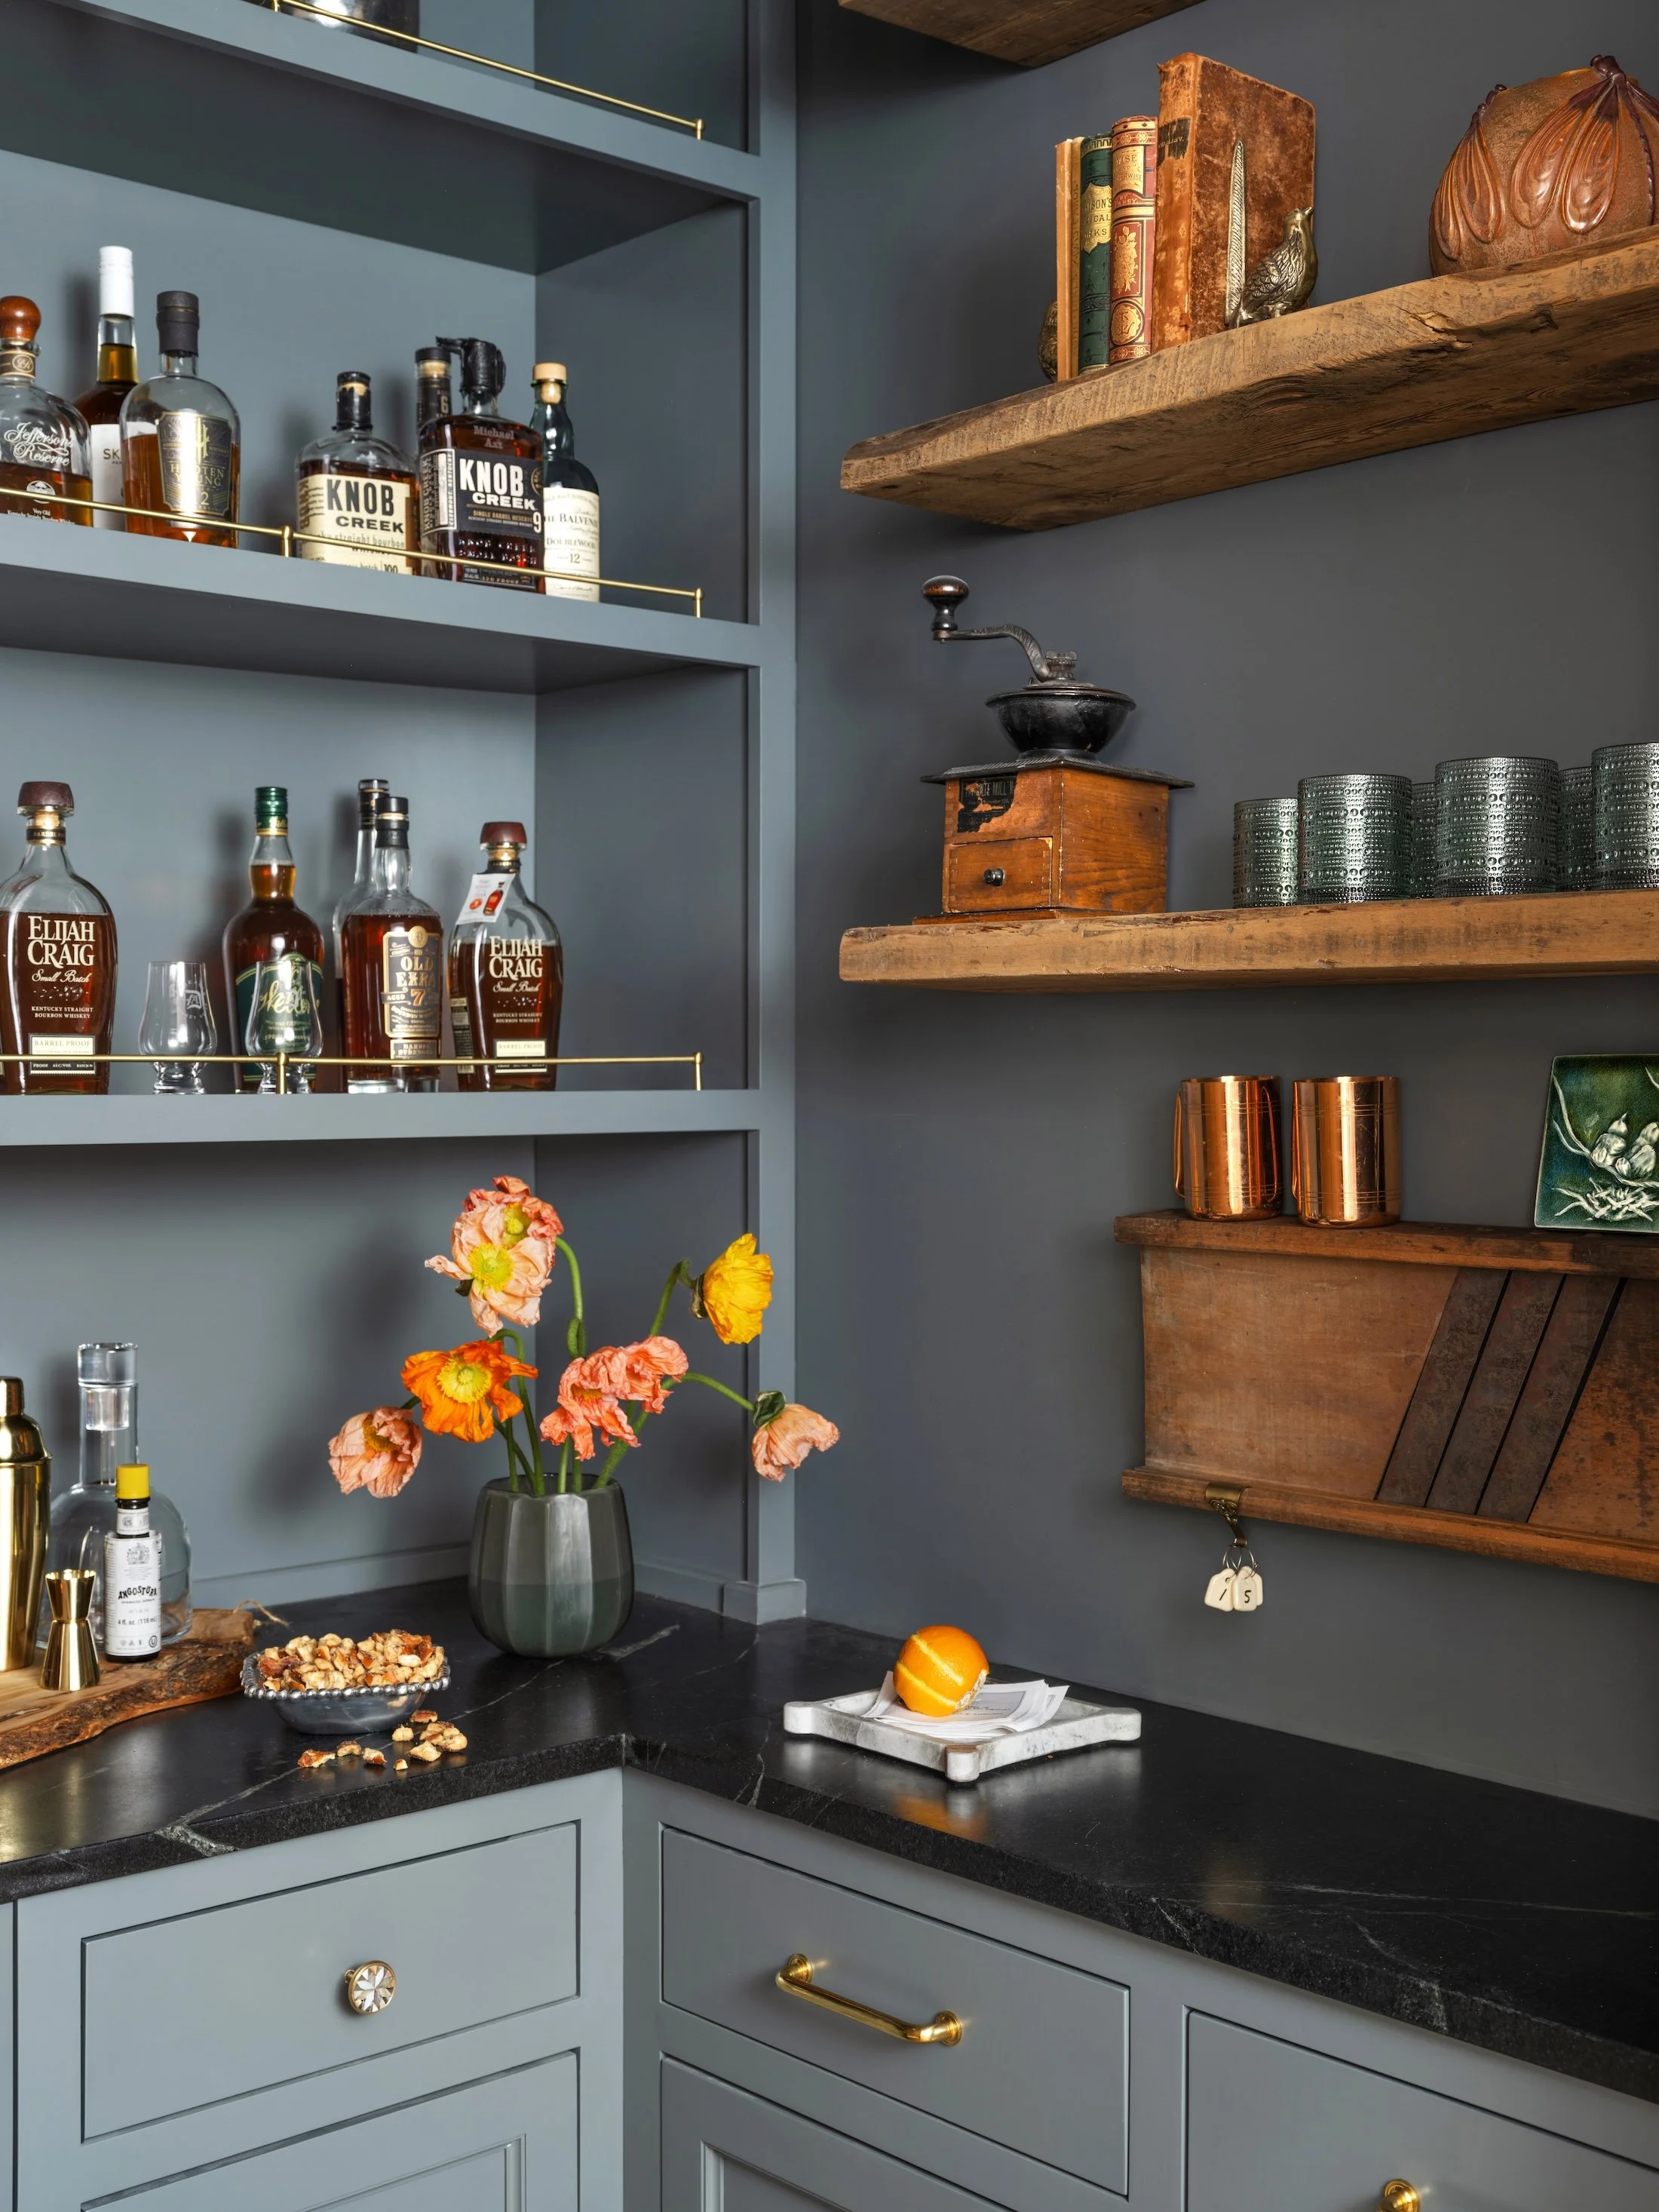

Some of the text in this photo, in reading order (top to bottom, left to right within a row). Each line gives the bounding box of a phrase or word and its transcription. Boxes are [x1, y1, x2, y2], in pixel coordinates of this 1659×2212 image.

[1115, 155, 1137, 166] WISE
[440, 395, 449, 414] 6
[473, 425, 514, 440] Michael
[485, 438, 503, 449] Axt
[14, 441, 70, 466] Reserve
[422, 457, 430, 497] CREEK
[459, 459, 524, 498] KNOB
[327, 479, 394, 517] KNOB
[472, 492, 537, 511] CREEK
[473, 510, 491, 518] SINGLE
[492, 511, 511, 520] BARREL
[532, 511, 542, 533] 9
[336, 516, 404, 533] CREEK
[373, 536, 405, 549] bourbon
[569, 553, 580, 564] 12
[28, 916, 96, 945] ELIJAH
[27, 940, 95, 969] CRAIG
[489, 936, 543, 960] ELIJAH
[400, 956, 434, 971] OLD
[489, 956, 543, 980] CRAIG
[32, 968, 92, 983] Small Batch
[395, 971, 436, 987] EZRA
[492, 980, 541, 992] Small Batch
[410, 988, 426, 1006] 7
[118, 1585, 158, 1600] ANGOSTURA
[1244, 1590, 1252, 1603] 5
